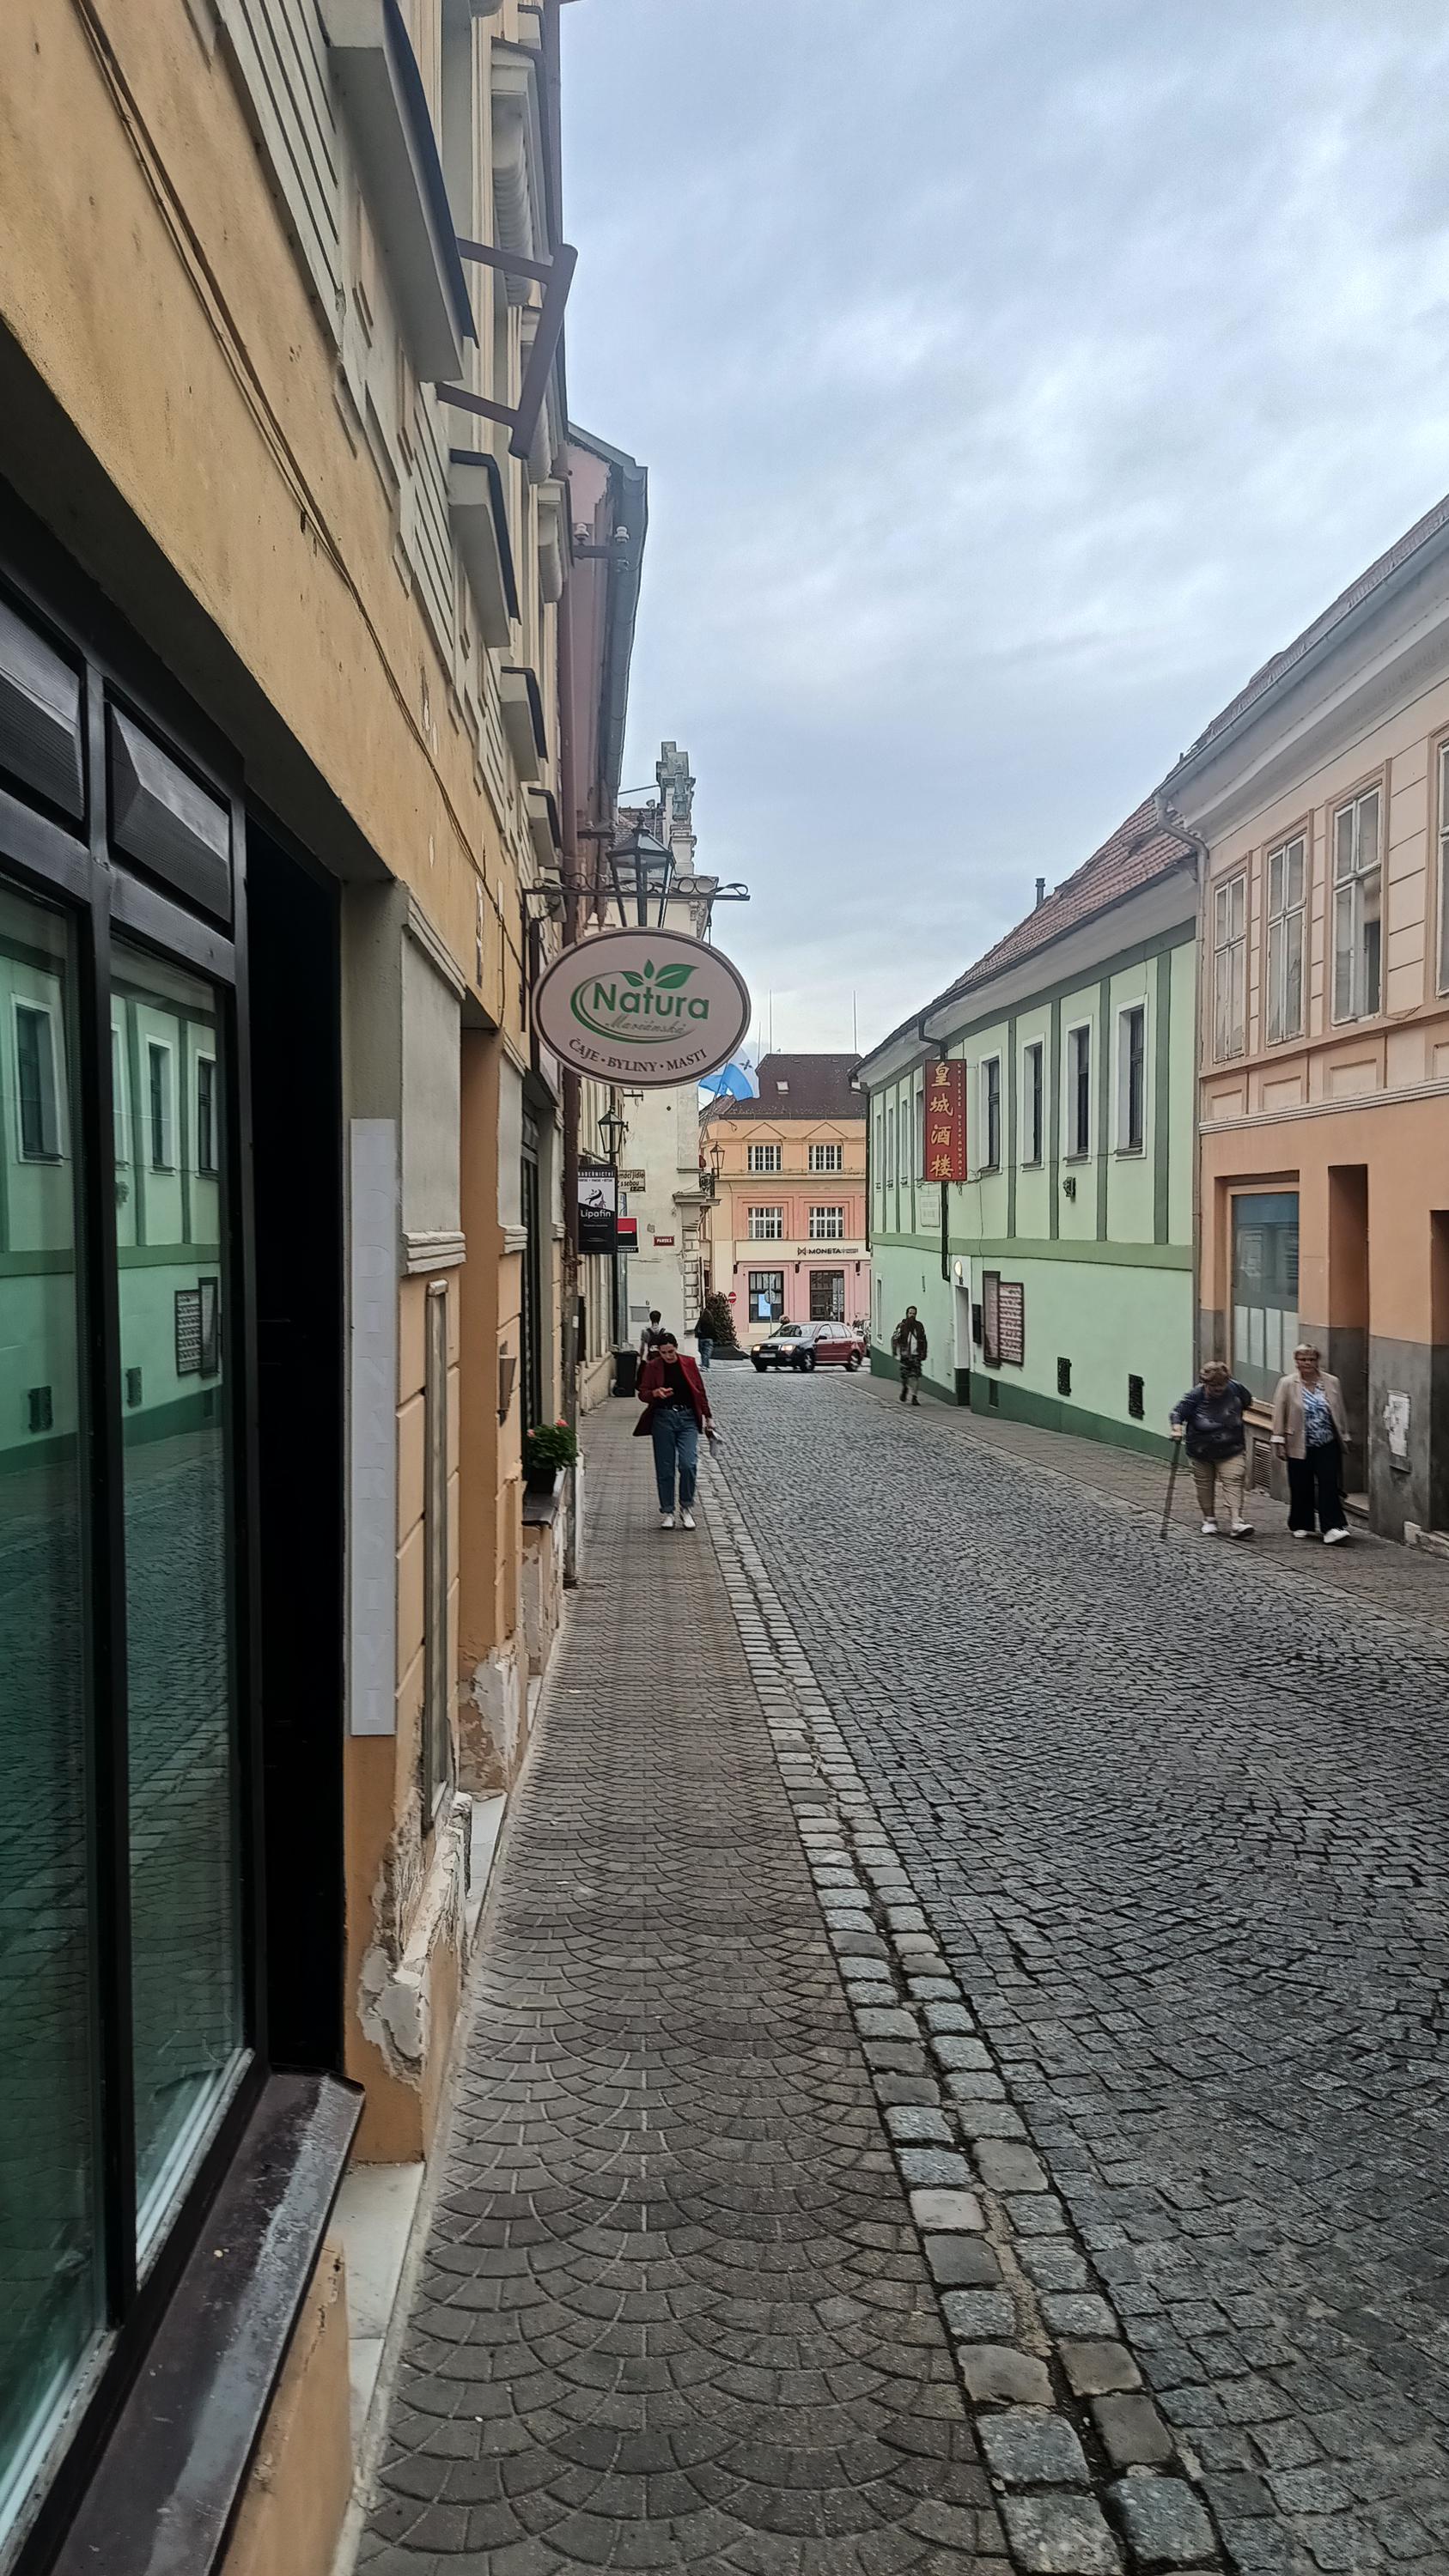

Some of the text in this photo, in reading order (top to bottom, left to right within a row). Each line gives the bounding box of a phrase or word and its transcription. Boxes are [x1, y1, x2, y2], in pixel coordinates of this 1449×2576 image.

[593, 981, 710, 1020] Natura
[568, 1037, 708, 1072] ČAJE BYLINY MASTI
